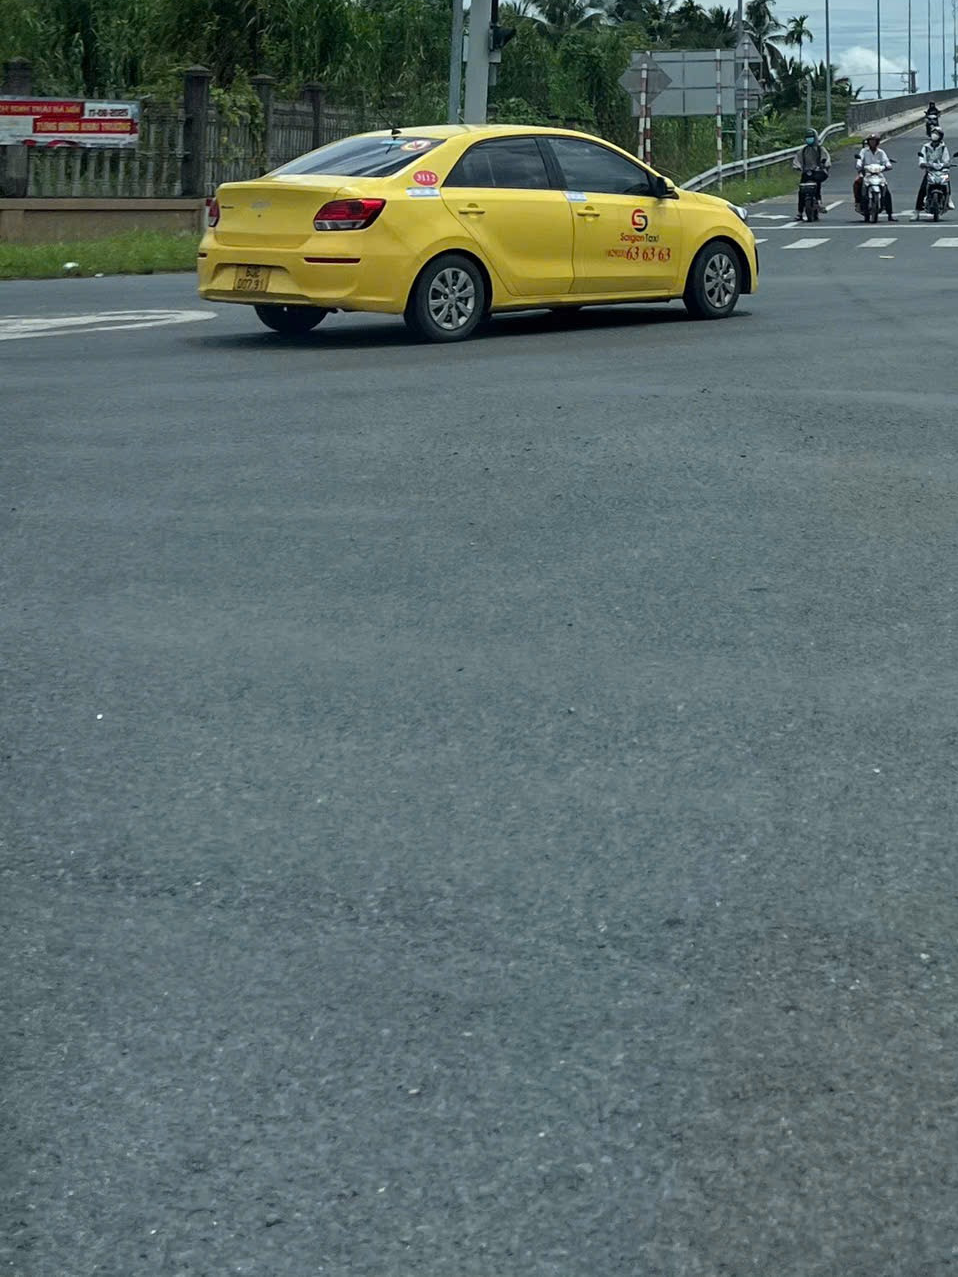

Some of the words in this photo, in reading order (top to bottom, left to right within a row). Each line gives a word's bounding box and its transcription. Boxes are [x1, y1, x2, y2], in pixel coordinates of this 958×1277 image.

[626, 246, 640, 261] 63
[642, 246, 656, 261] 63
[658, 247, 671, 262] 63
